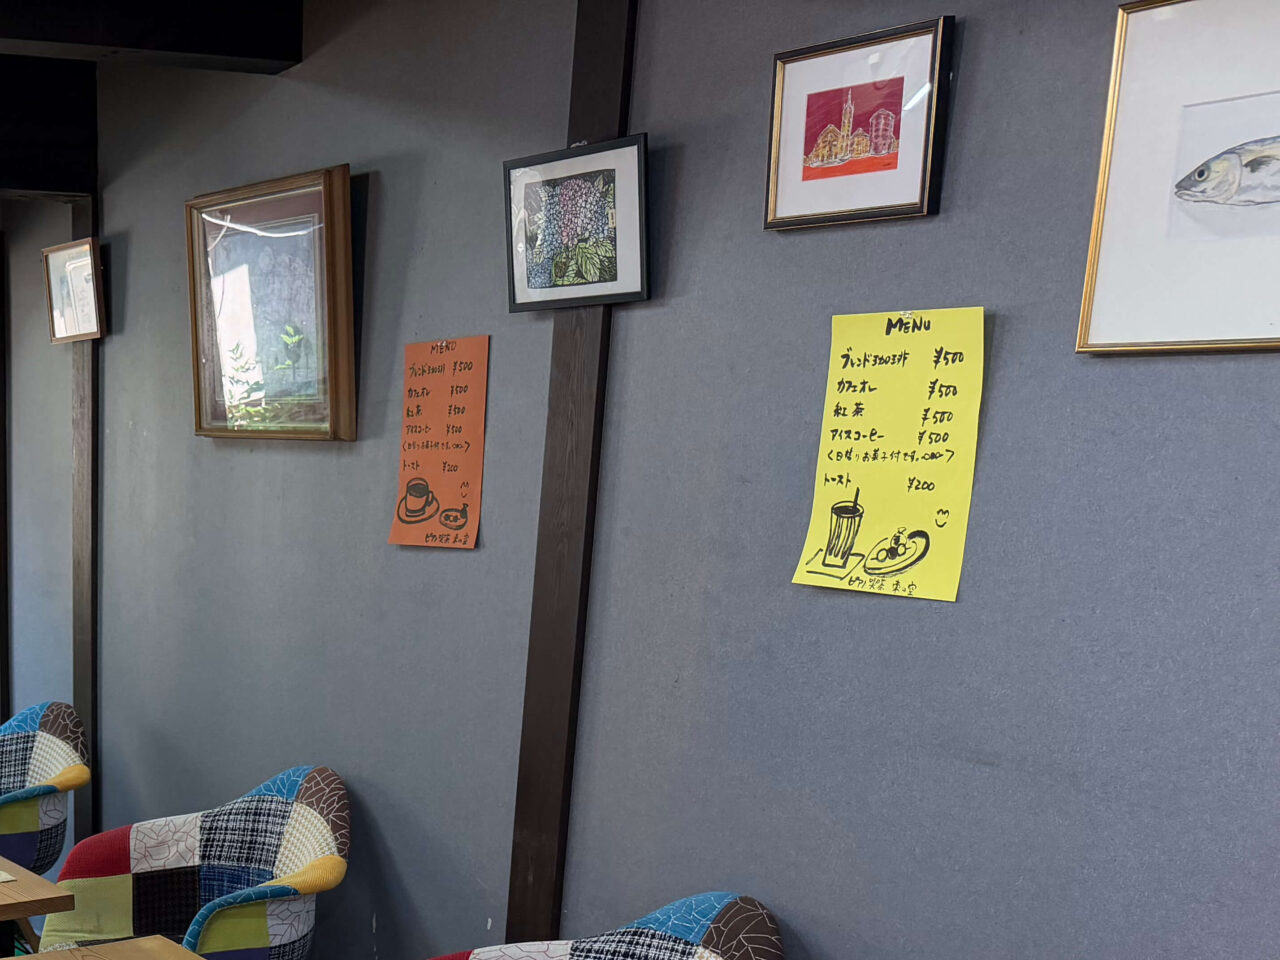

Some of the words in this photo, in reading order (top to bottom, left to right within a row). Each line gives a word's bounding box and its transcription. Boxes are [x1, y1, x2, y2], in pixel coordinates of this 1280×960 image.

[885, 316, 931, 335] MENU
[933, 345, 965, 370] ¥500
[452, 360, 474, 376] ¥500
[450, 384, 469, 398] ¥500
[837, 377, 878, 394] カフェオレ
[928, 378, 958, 400] ¥500
[448, 404, 466, 418] ¥500
[921, 408, 954, 428] ¥500
[446, 423, 463, 436] ¥500
[830, 428, 885, 442] アイスコーヒー
[917, 430, 950, 445] ¥500
[824, 472, 852, 489] トースト
[907, 476, 936, 493] ¥200
